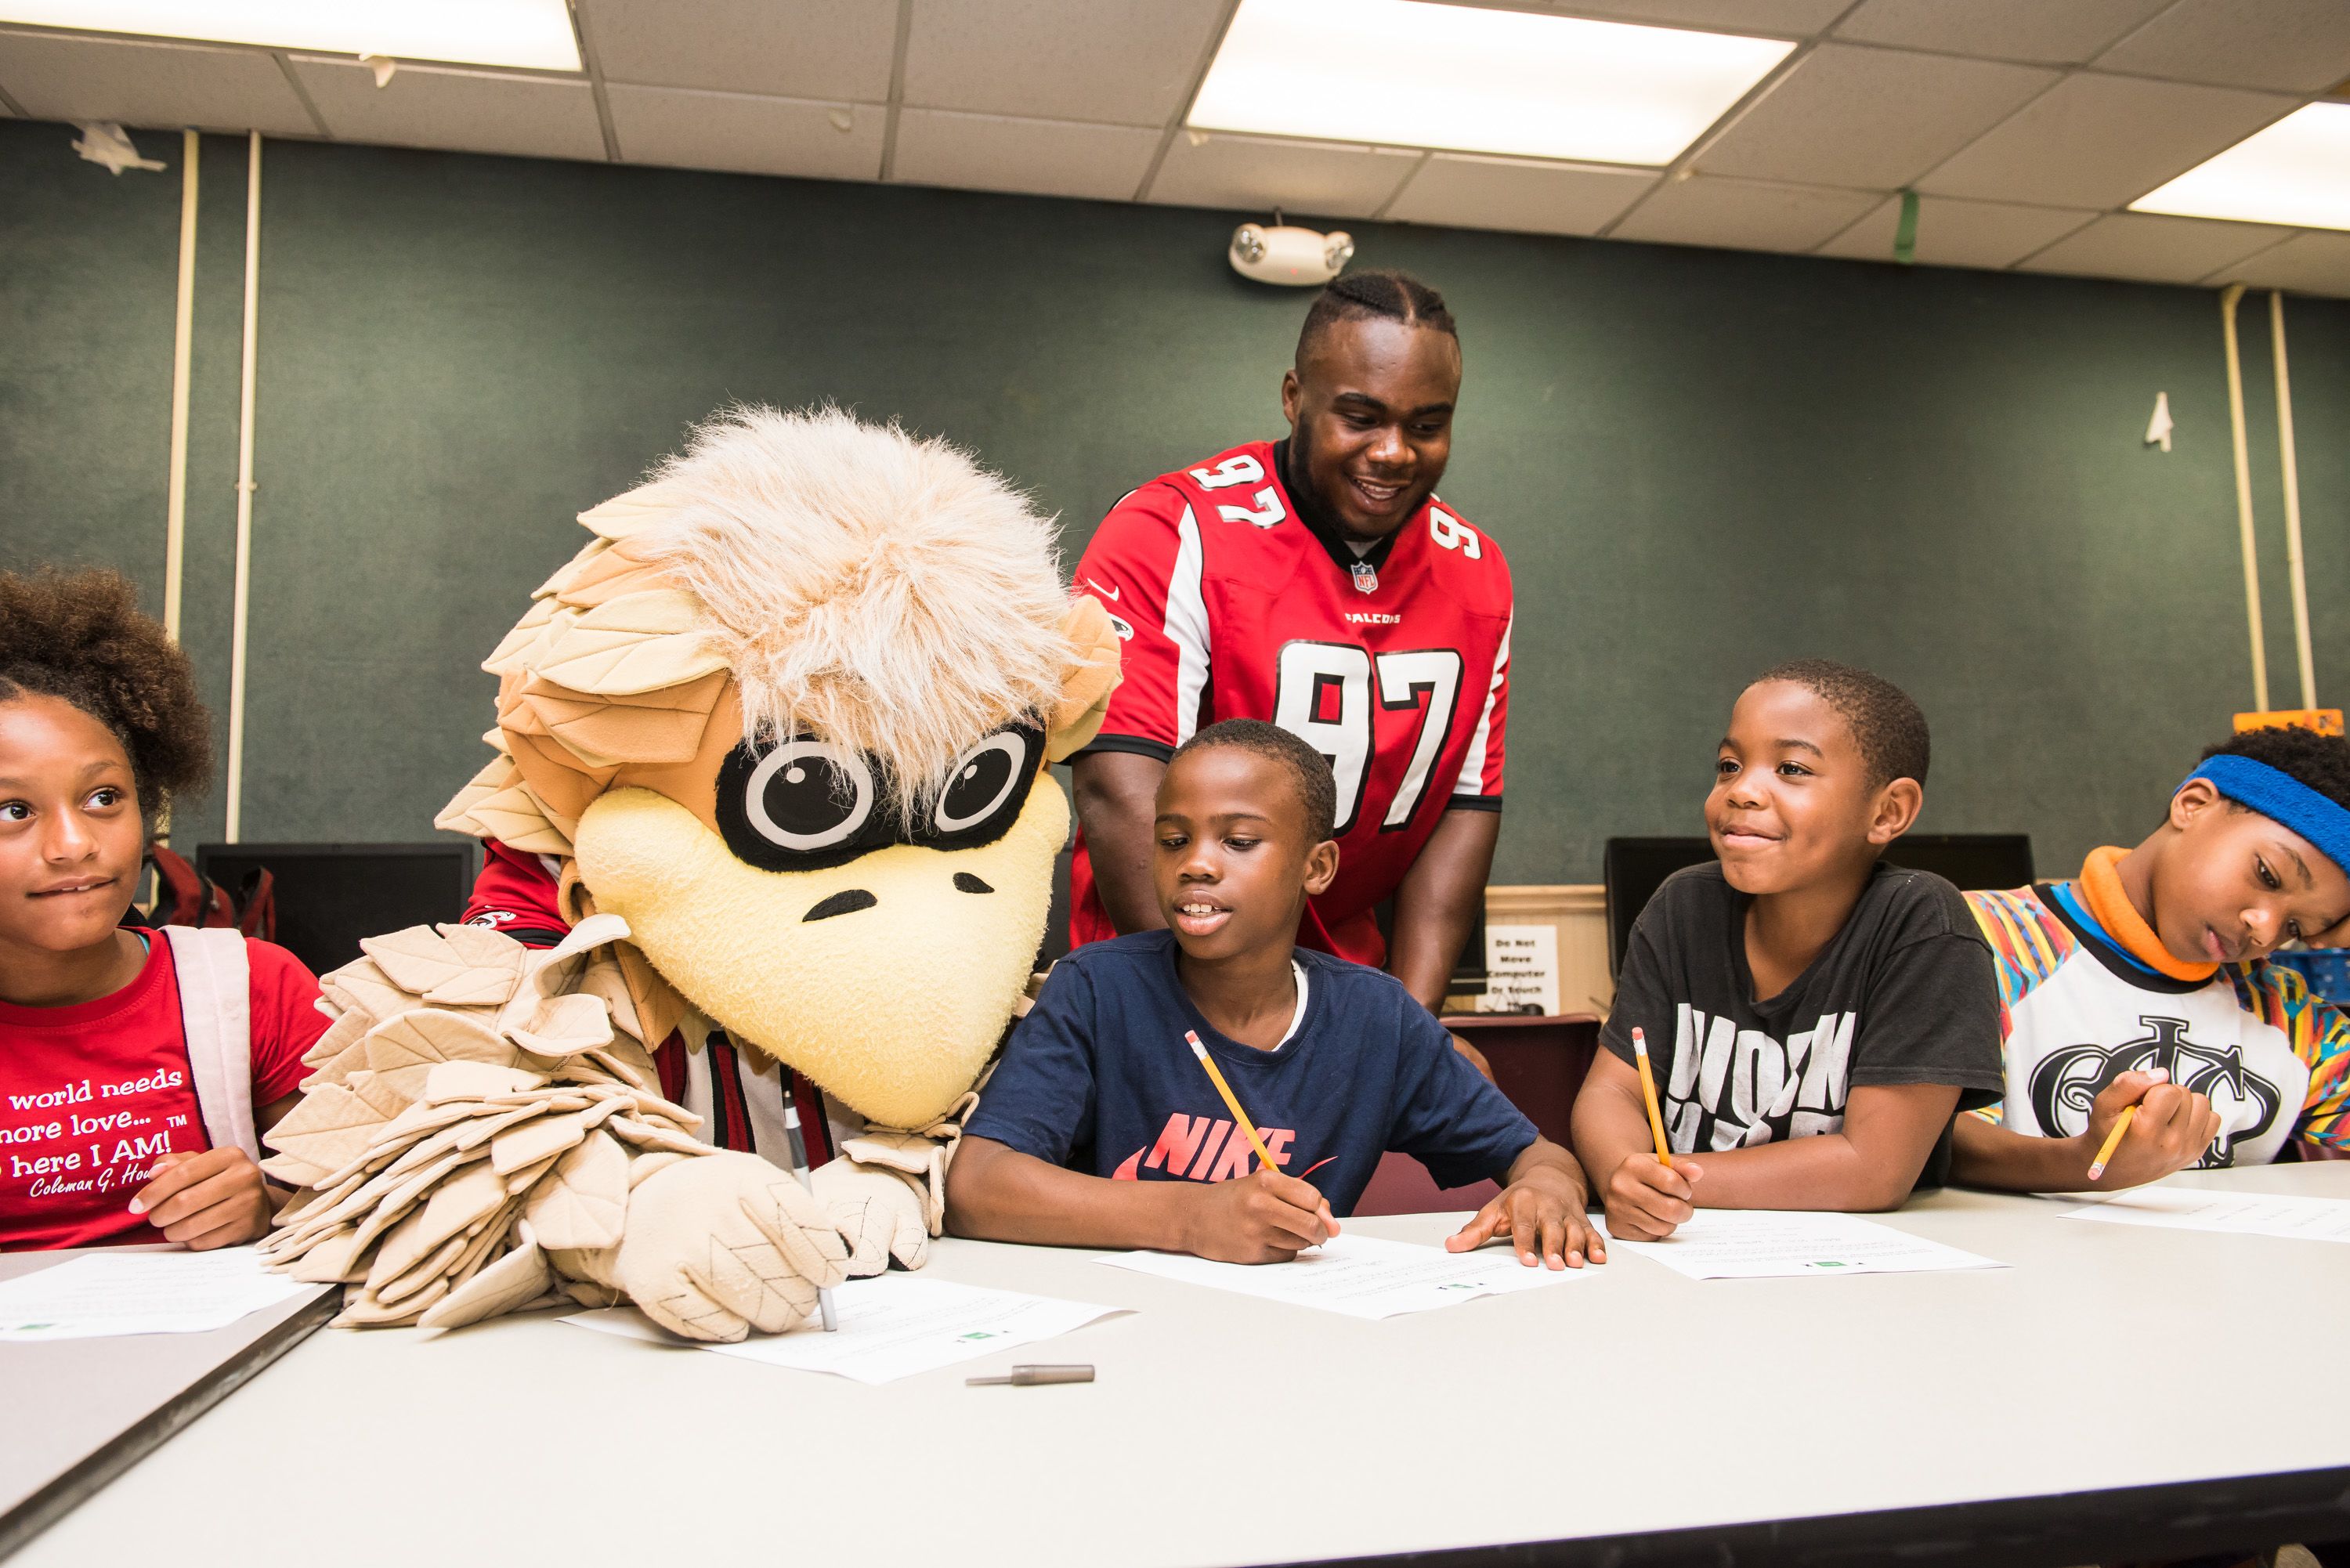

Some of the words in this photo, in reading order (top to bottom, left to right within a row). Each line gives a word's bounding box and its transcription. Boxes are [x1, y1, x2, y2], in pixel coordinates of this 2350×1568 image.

[1188, 453, 1287, 529] 97
[1429, 492, 1482, 561] 9
[1358, 575, 1375, 587] NFL
[1271, 638, 1465, 838] 97
[9, 1079, 92, 1111] world
[101, 1068, 183, 1098] needs
[70, 1111, 151, 1136] love...
[166, 1114, 187, 1129] TM
[11, 1152, 81, 1178] here
[90, 1143, 102, 1167] I
[110, 1131, 172, 1165] AM!
[1144, 1112, 1296, 1183] NIKE
[30, 1176, 92, 1198] Coleman
[97, 1168, 115, 1193] G.
